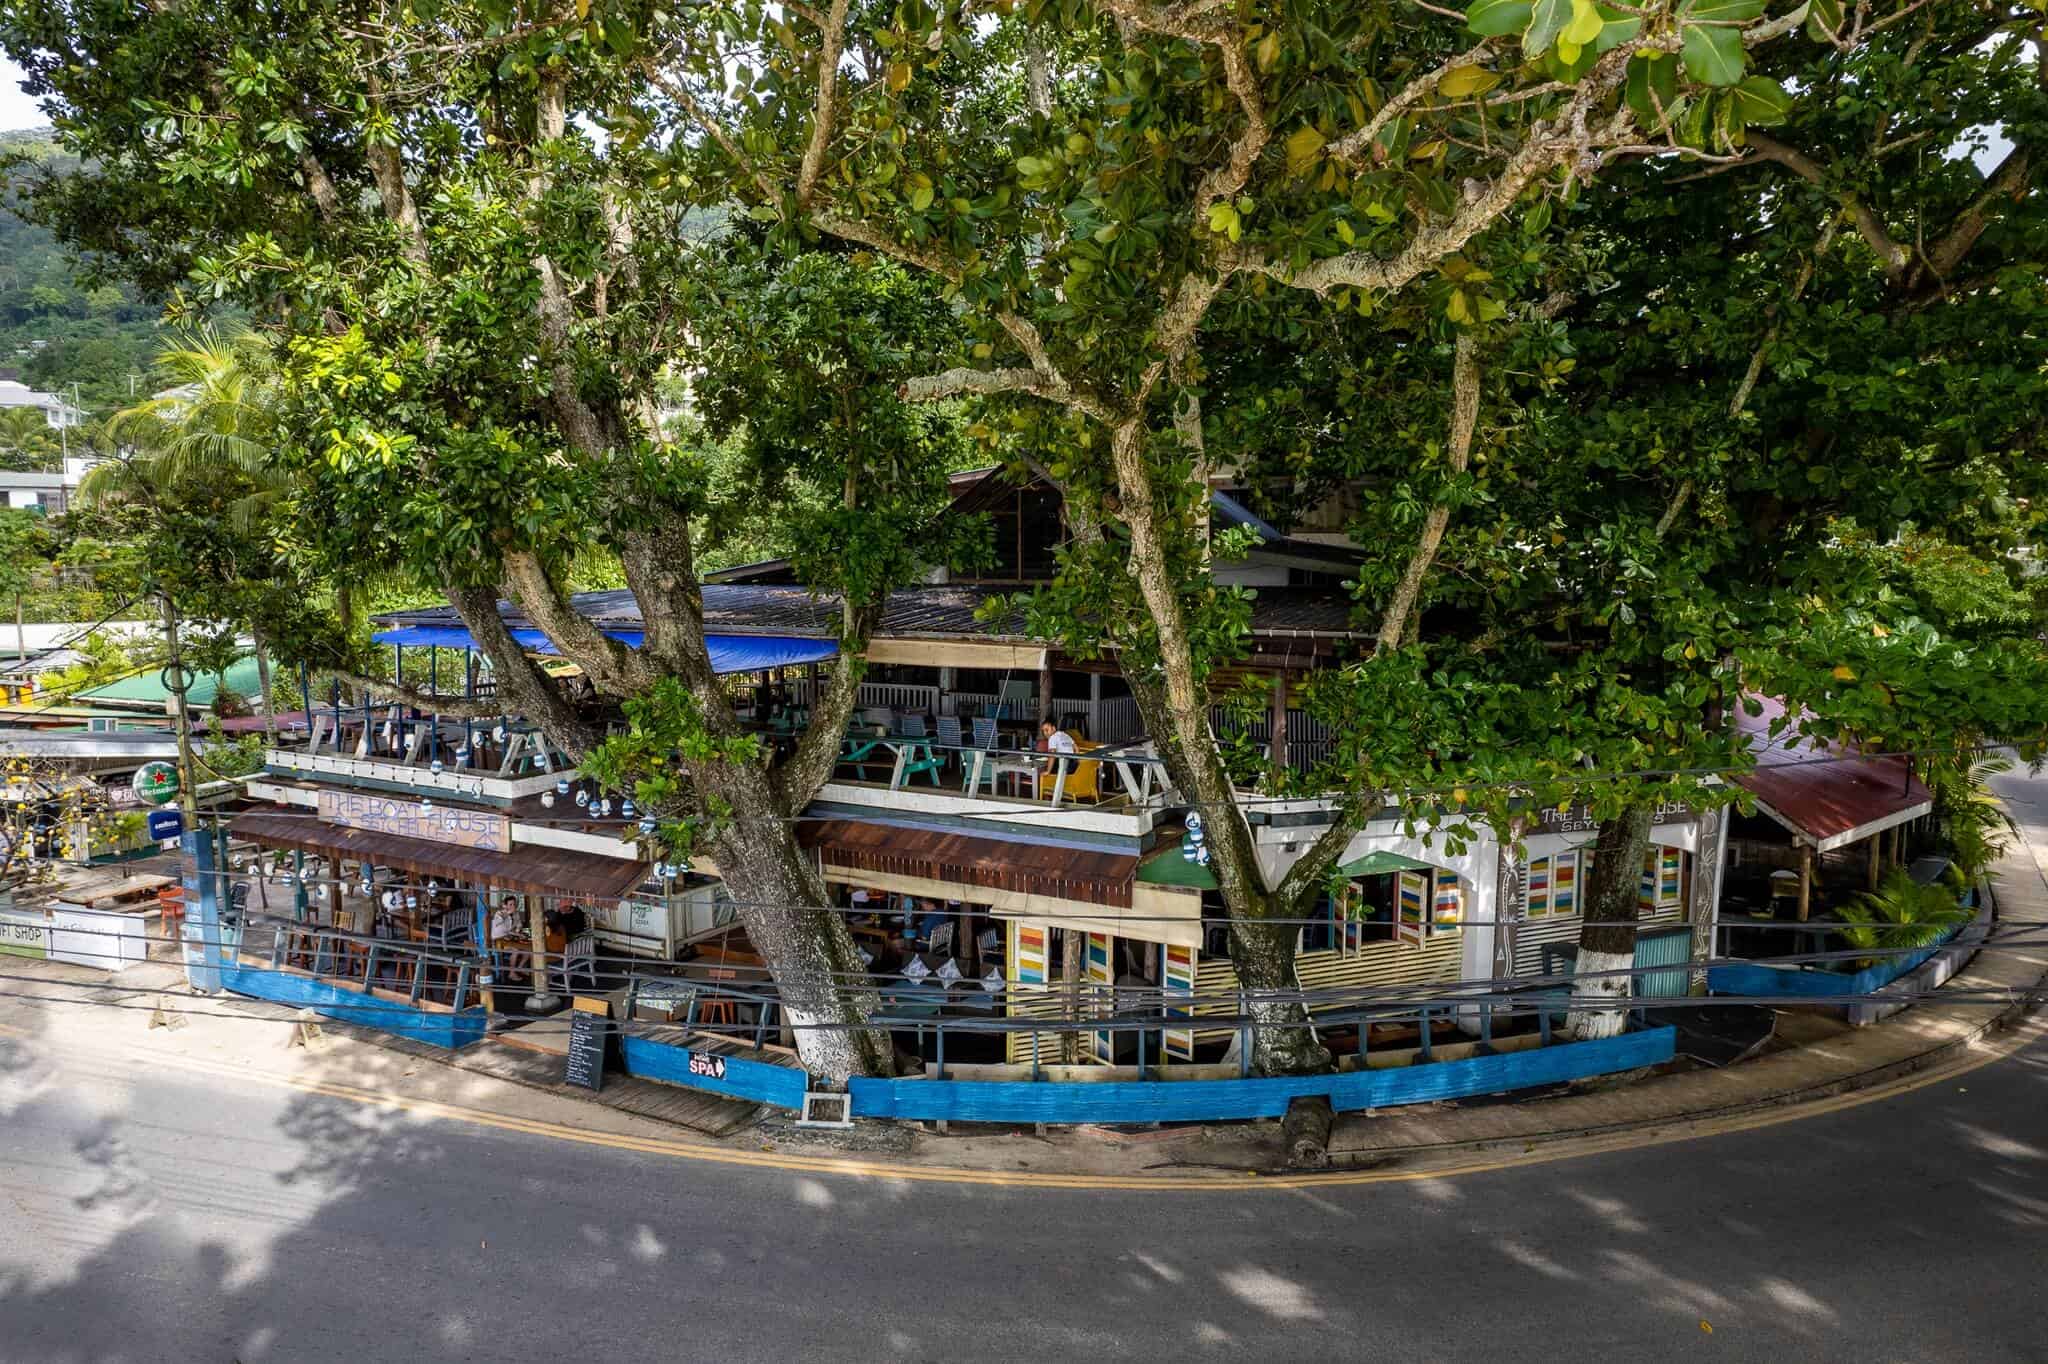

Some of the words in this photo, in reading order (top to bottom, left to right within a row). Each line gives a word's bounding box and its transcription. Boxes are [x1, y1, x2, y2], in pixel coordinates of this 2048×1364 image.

[325, 791, 362, 813] THE
[368, 797, 422, 818] BOAT
[428, 807, 501, 833] HOUSE
[1541, 804, 1574, 824] THE
[15, 927, 42, 941] SHOP
[690, 1060, 715, 1077] SPA
